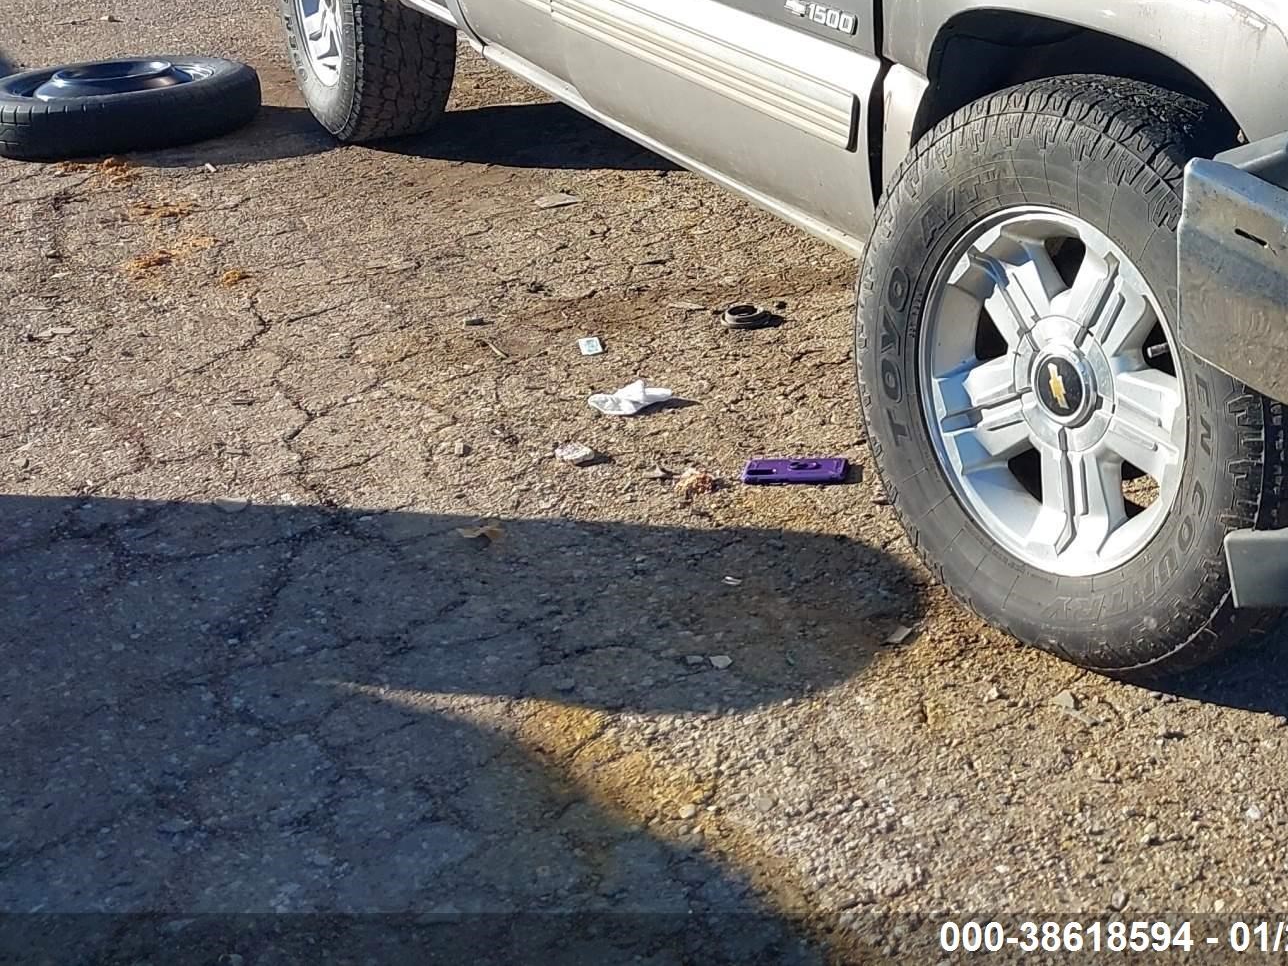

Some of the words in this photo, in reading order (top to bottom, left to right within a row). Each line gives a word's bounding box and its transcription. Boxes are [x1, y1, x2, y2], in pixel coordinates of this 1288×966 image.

[808, 2, 857, 36] 1500
[881, 265, 914, 448] TOYO
[1042, 480, 1207, 620] COUNTRY
